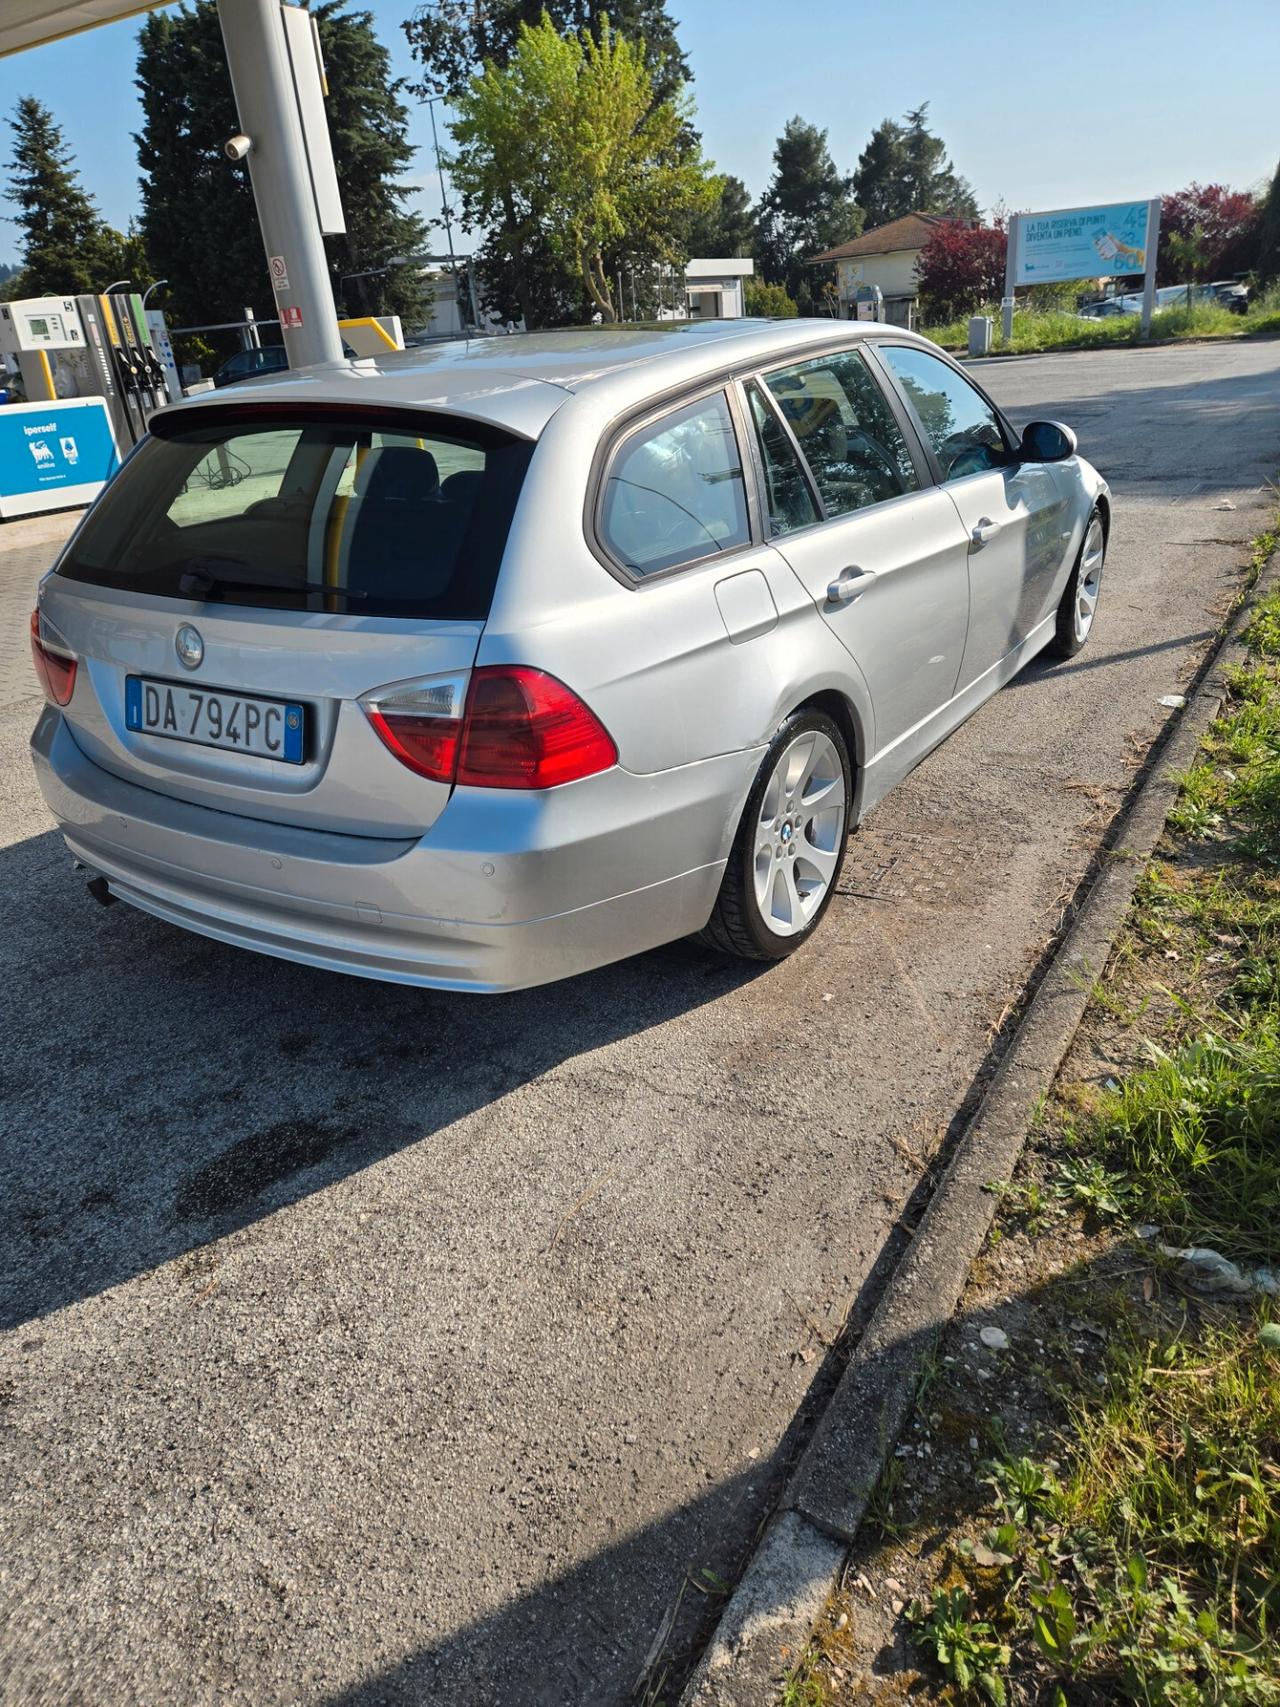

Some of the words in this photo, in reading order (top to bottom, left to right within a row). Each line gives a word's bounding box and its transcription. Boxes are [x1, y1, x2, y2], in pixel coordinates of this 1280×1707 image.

[1026, 223, 1035, 233] LA
[1037, 221, 1050, 232] TUA
[1051, 218, 1078, 230] RISERVA
[1079, 217, 1085, 227] DI
[1086, 214, 1106, 226] PUNTI
[1025, 230, 1052, 242] DIVENTA
[1053, 229, 1063, 239] UN
[65, 301, 73, 312] 5
[23, 422, 57, 436] iperself
[145, 685, 177, 731] DA
[189, 693, 281, 751] 794PC
